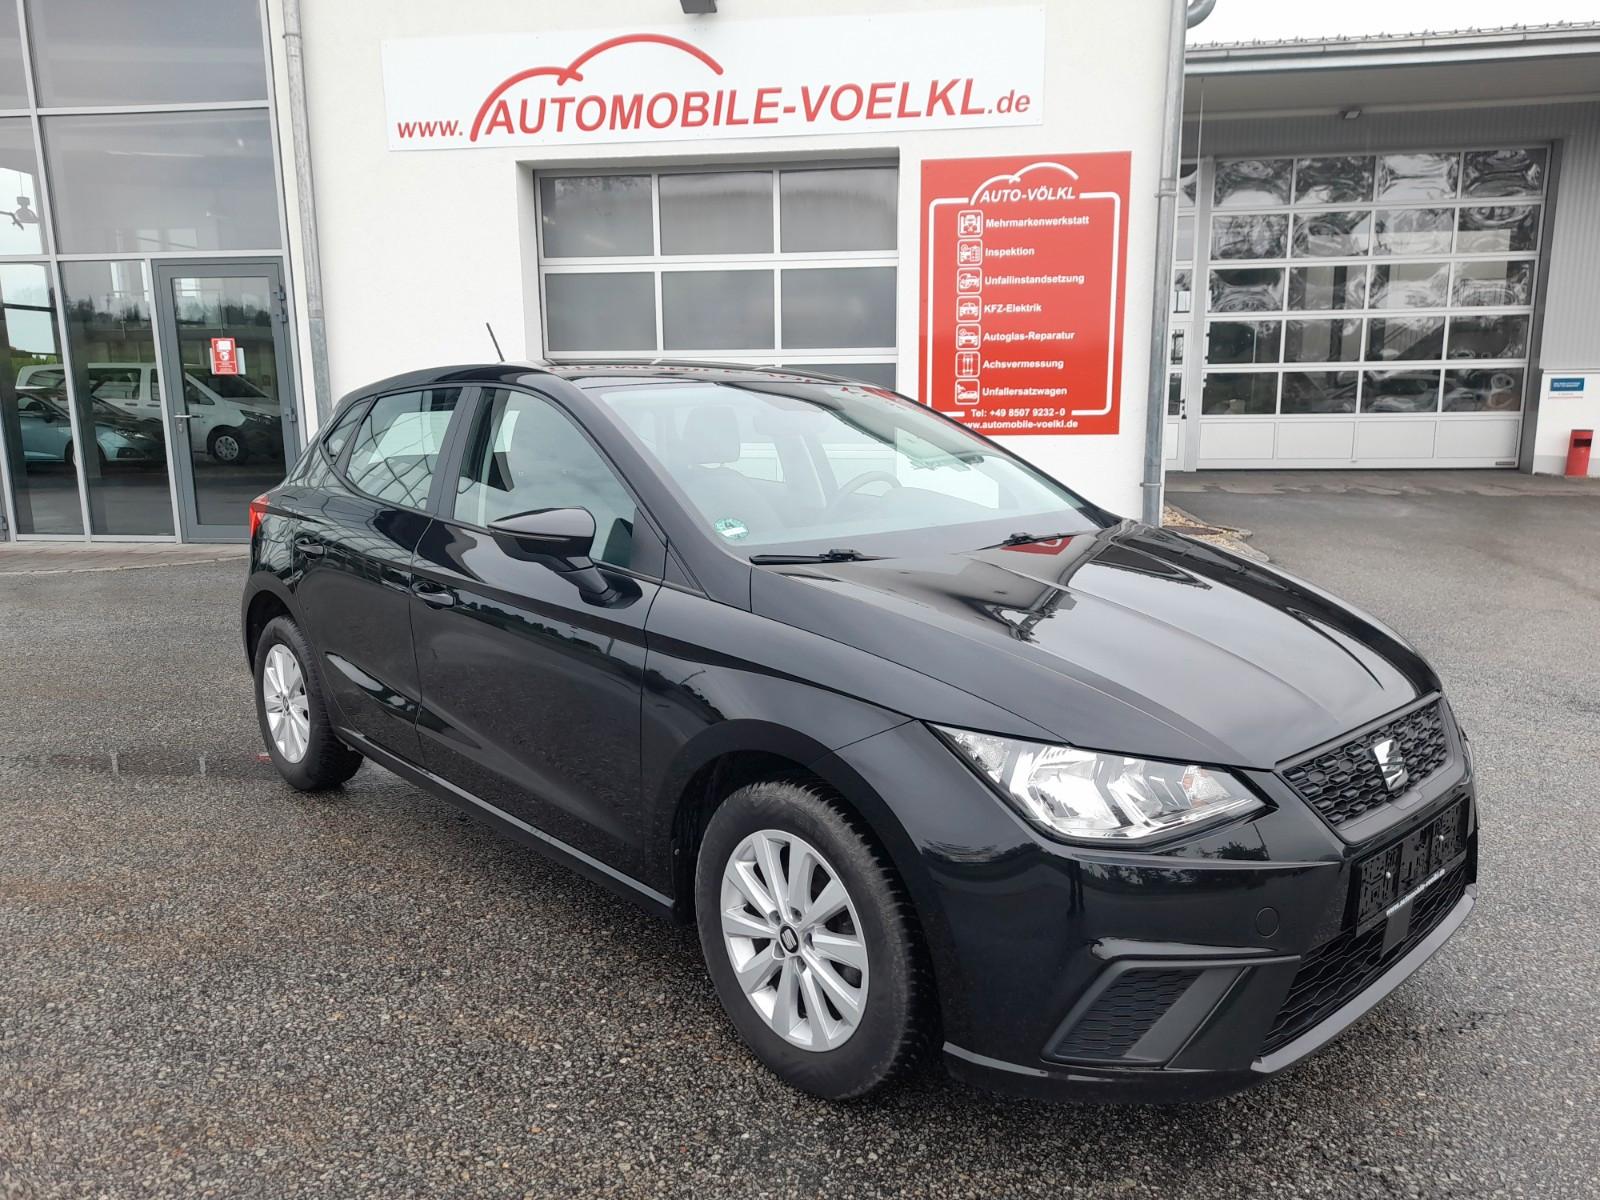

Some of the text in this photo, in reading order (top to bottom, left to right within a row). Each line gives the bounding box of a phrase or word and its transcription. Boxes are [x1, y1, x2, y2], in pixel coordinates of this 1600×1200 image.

[979, 185, 1076, 204] AUTO-VÖLKL
[985, 215, 1090, 228] Mehrmarkenwerkstatt
[985, 246, 1035, 259] Inspektion
[984, 274, 1085, 286] Unfallinstandsetzung
[984, 303, 1042, 313] KFZ-Elektrik
[983, 330, 1075, 343] Autoglas-Reparatur
[982, 359, 1064, 370] Achsvermessung
[982, 387, 1068, 398] Unfallersatzwagen
[970, 408, 987, 418] Tel:
[990, 408, 1007, 417] +49
[1008, 408, 1030, 417] 8507
